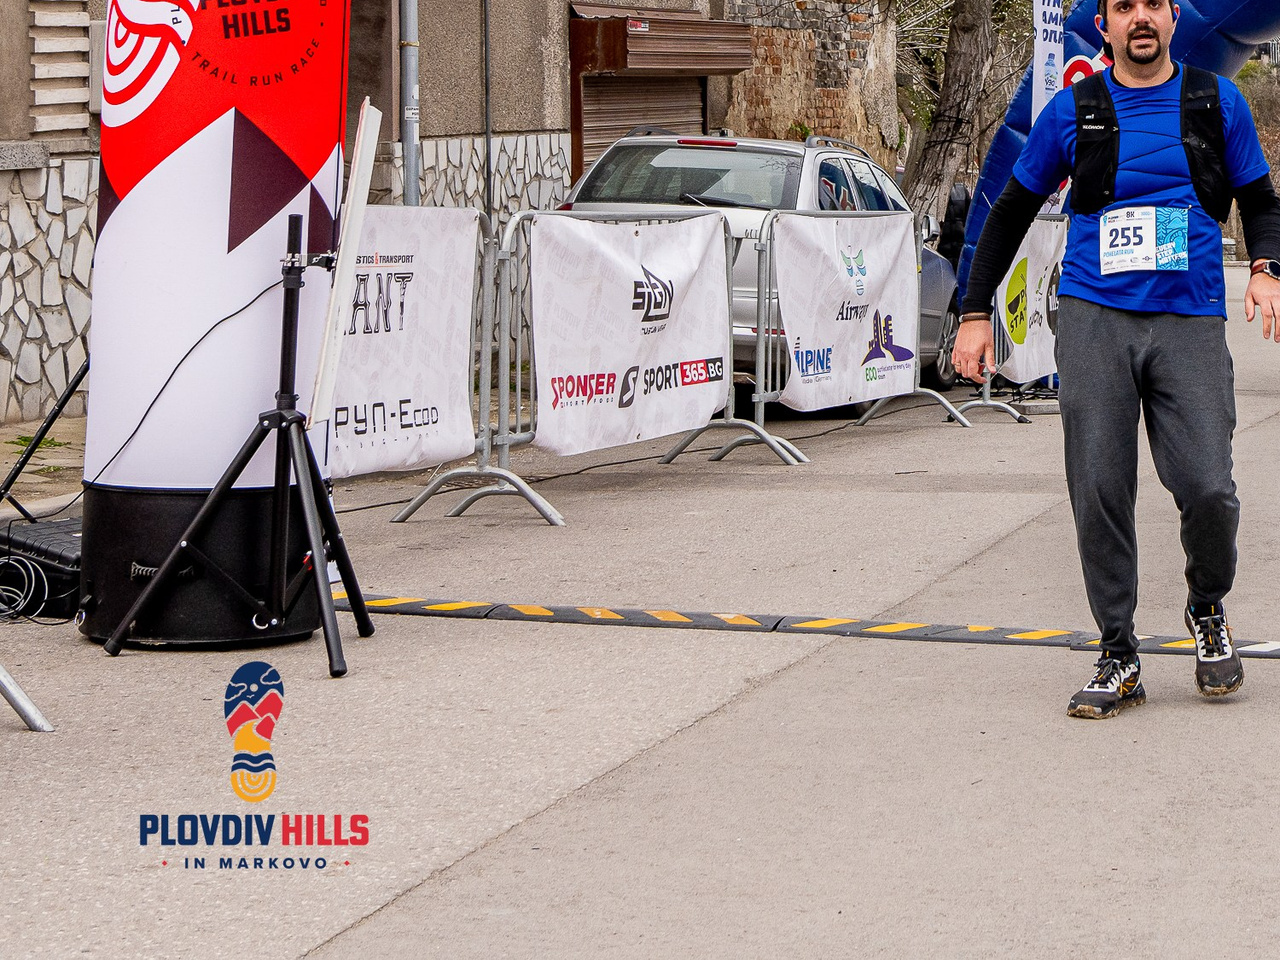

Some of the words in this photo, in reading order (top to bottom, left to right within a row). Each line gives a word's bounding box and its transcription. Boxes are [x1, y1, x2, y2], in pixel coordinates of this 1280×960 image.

[221, 7, 291, 39] HILLS
[191, 51, 238, 84] TRAIL
[250, 72, 283, 87] RUN
[290, 38, 319, 74] RACE
[1109, 226, 1143, 248] 255
[356, 255, 374, 264] STICS
[379, 255, 414, 264] TRANSPORT
[344, 272, 414, 335] ANT
[865, 366, 877, 381] ECO
